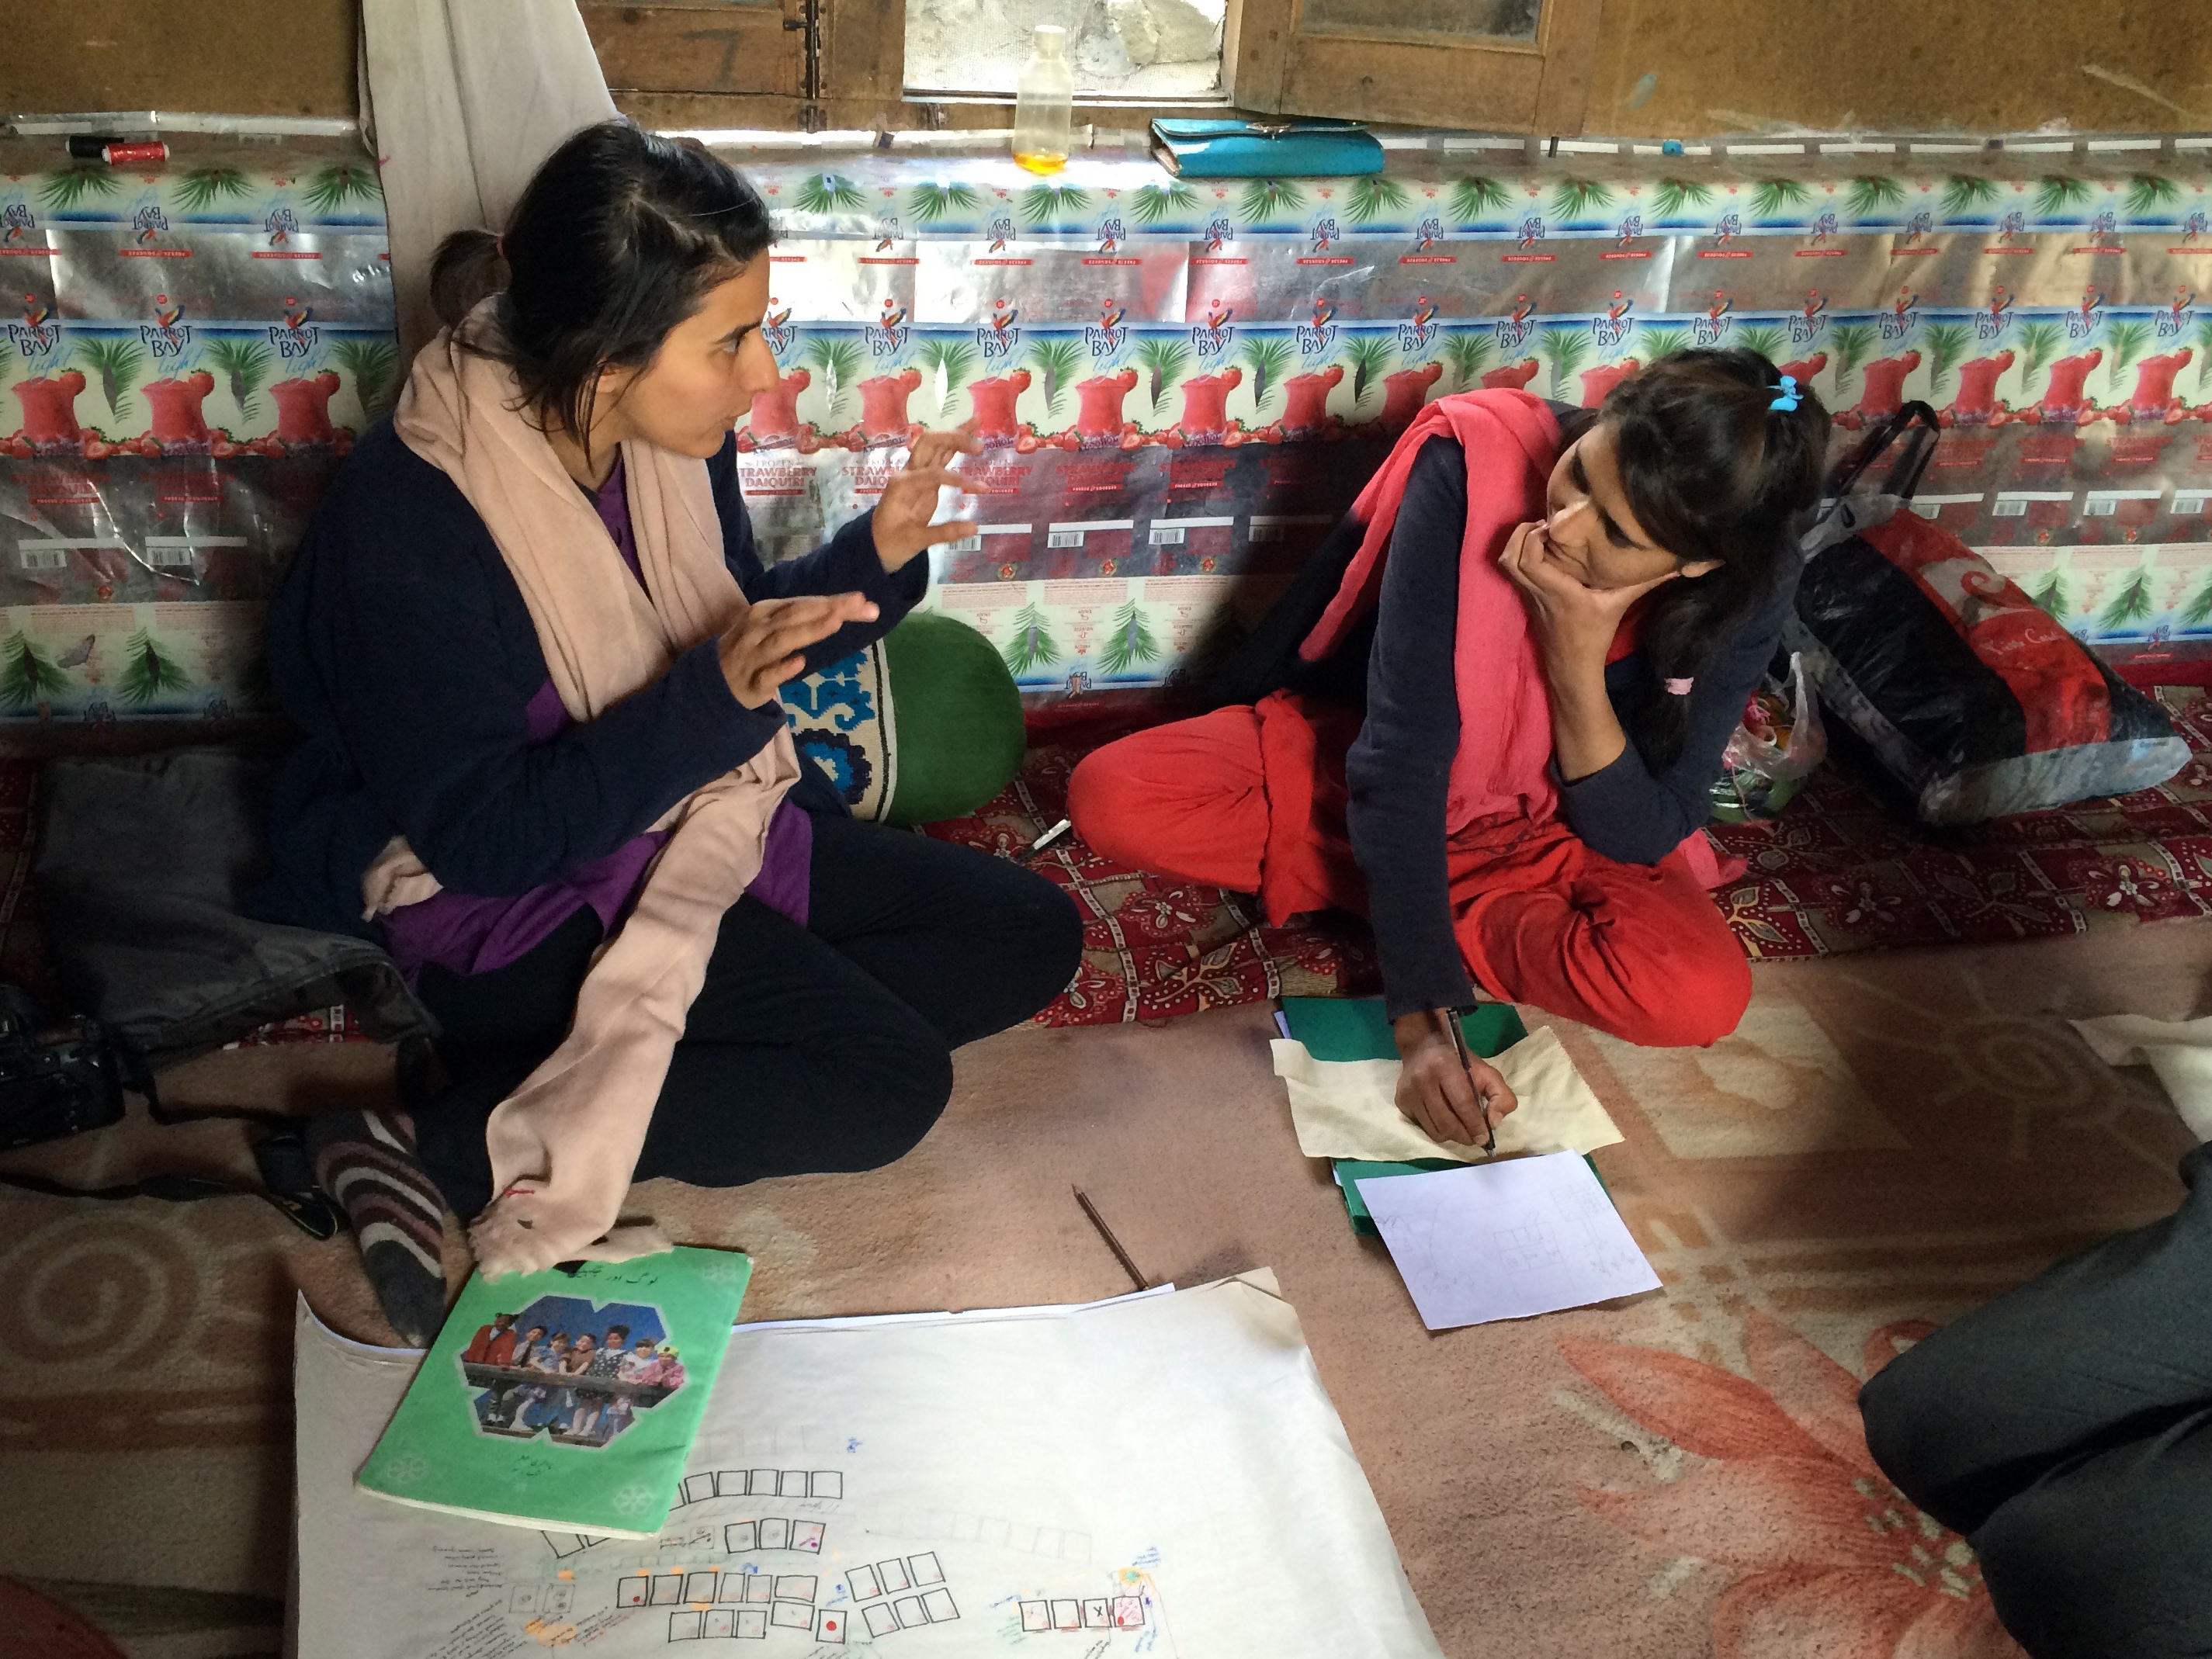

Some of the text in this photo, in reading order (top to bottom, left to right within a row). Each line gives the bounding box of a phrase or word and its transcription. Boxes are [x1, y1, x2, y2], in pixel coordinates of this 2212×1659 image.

[4, 204, 27, 218] BAY
[140, 206, 161, 218] BAY
[270, 209, 292, 222] BAY
[0, 214, 36, 229] PARROT
[133, 216, 168, 231] PARROT
[265, 219, 299, 234] PARROT
[991, 219, 1011, 230] BAY
[1101, 219, 1121, 231] BAY
[1212, 219, 1229, 231] BAY
[1319, 219, 1336, 231] BAY
[1421, 218, 1439, 230] BAY
[1524, 217, 1541, 230] BAY
[1622, 215, 1641, 227] BAY
[1721, 213, 1739, 226] BAY
[986, 227, 1016, 241] PARROT
[1096, 227, 1125, 241] PARROT
[1204, 227, 1233, 241] PARROT
[1310, 227, 1340, 241] PARROT
[1416, 227, 1444, 240] PARROT
[1517, 226, 1545, 239] PARROT
[1616, 223, 1642, 236] PARROT
[1714, 223, 1742, 236] PARROT
[1593, 317, 1635, 334] PARROT
[1694, 317, 1732, 334] PARROT
[1789, 315, 1829, 331] PARROT
[1879, 312, 1919, 328] PARROT
[1975, 312, 2014, 328] PARROT
[2066, 310, 2105, 327] PARROT
[2155, 310, 2195, 326] PARROT
[8, 324, 61, 343] PARROT
[140, 325, 191, 343] PARROT
[269, 327, 319, 345] PARROT
[762, 327, 798, 344] ARROT
[865, 327, 911, 344] PARROT
[977, 327, 1021, 345] PARROT
[1085, 327, 1129, 344] PARROT
[1192, 327, 1235, 343] PARROT
[1296, 326, 1339, 343] PARROT
[1399, 324, 1439, 340] PARROT
[1496, 320, 1537, 337] PARROT
[1793, 327, 1820, 342] BAY
[1883, 324, 1910, 339] BAY
[1978, 324, 2006, 339] BAY
[2070, 323, 2097, 338] BAY
[2158, 322, 2186, 337] BAY
[1402, 336, 1431, 352] BAY
[1500, 333, 1527, 348] BAY
[1597, 331, 1624, 345] BAY
[1697, 329, 1722, 345] BAY
[21, 340, 54, 357] BAY
[152, 341, 185, 358] BAY
[281, 341, 314, 358] BAY
[764, 341, 789, 356] AY
[872, 341, 905, 356] BAY
[984, 341, 1013, 358] BAY
[1092, 340, 1122, 358] BAY
[1198, 341, 1227, 355] BAY
[1302, 339, 1331, 354] BAY
[983, 438, 1014, 450] COHOL
[739, 467, 817, 476] TRAWBERRY
[745, 477, 804, 487] DAIQUIRI
[855, 476, 887, 487] DAIQ
[1064, 677, 1091, 690] PAOT
